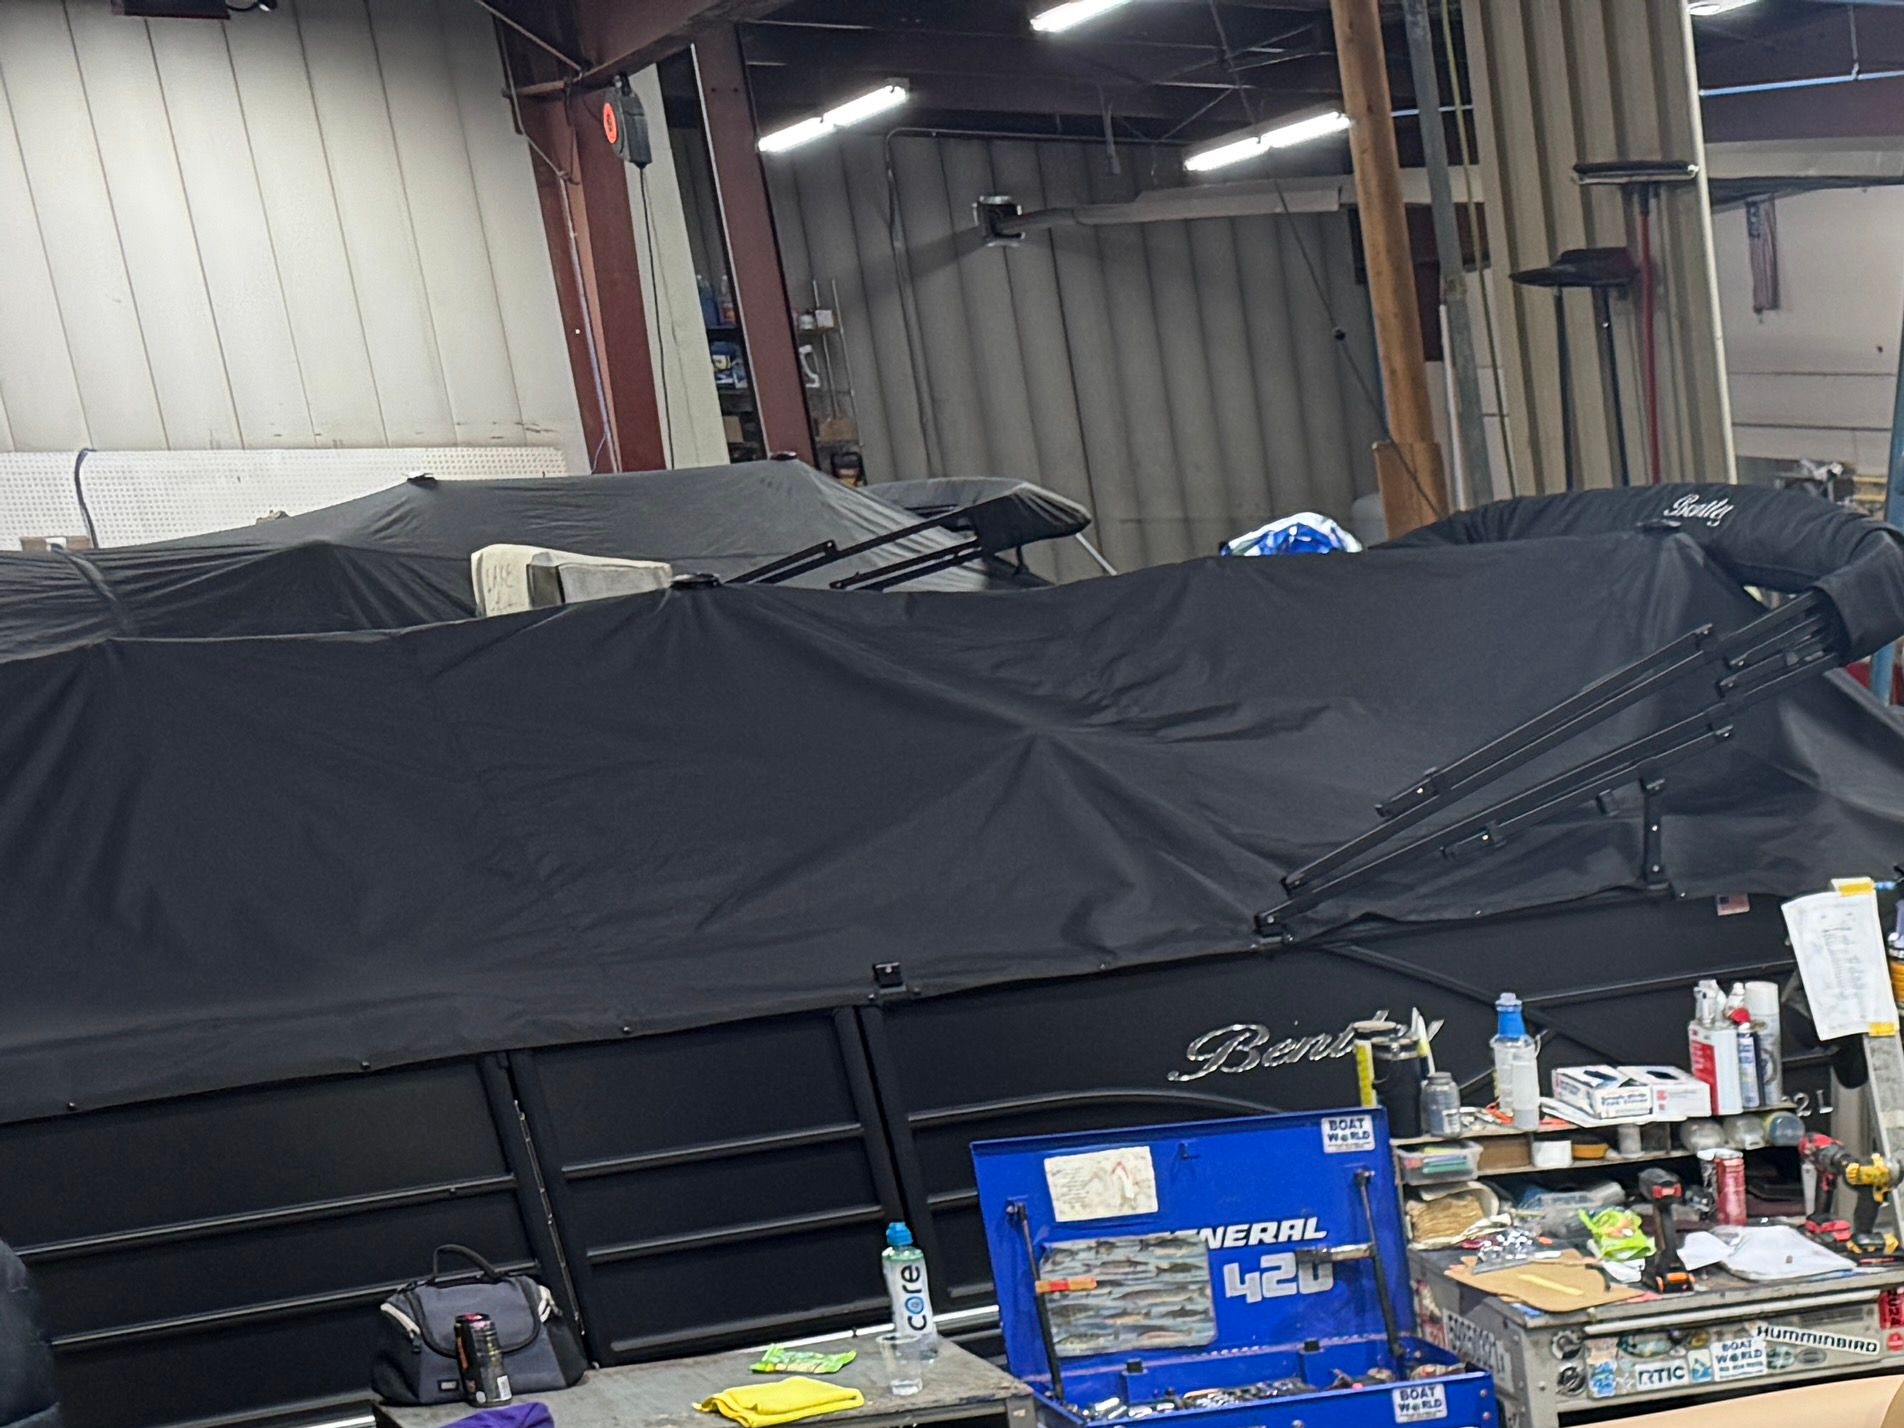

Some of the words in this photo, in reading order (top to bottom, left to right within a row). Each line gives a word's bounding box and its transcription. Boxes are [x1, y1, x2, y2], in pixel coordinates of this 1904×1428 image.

[1328, 1117, 1365, 1131] BOAT
[1150, 1217, 1328, 1250] NERAL
[900, 1264, 928, 1332] core
[1756, 1325, 1878, 1354] HUMMINBIRD
[1400, 1385, 1437, 1402] BOAT
